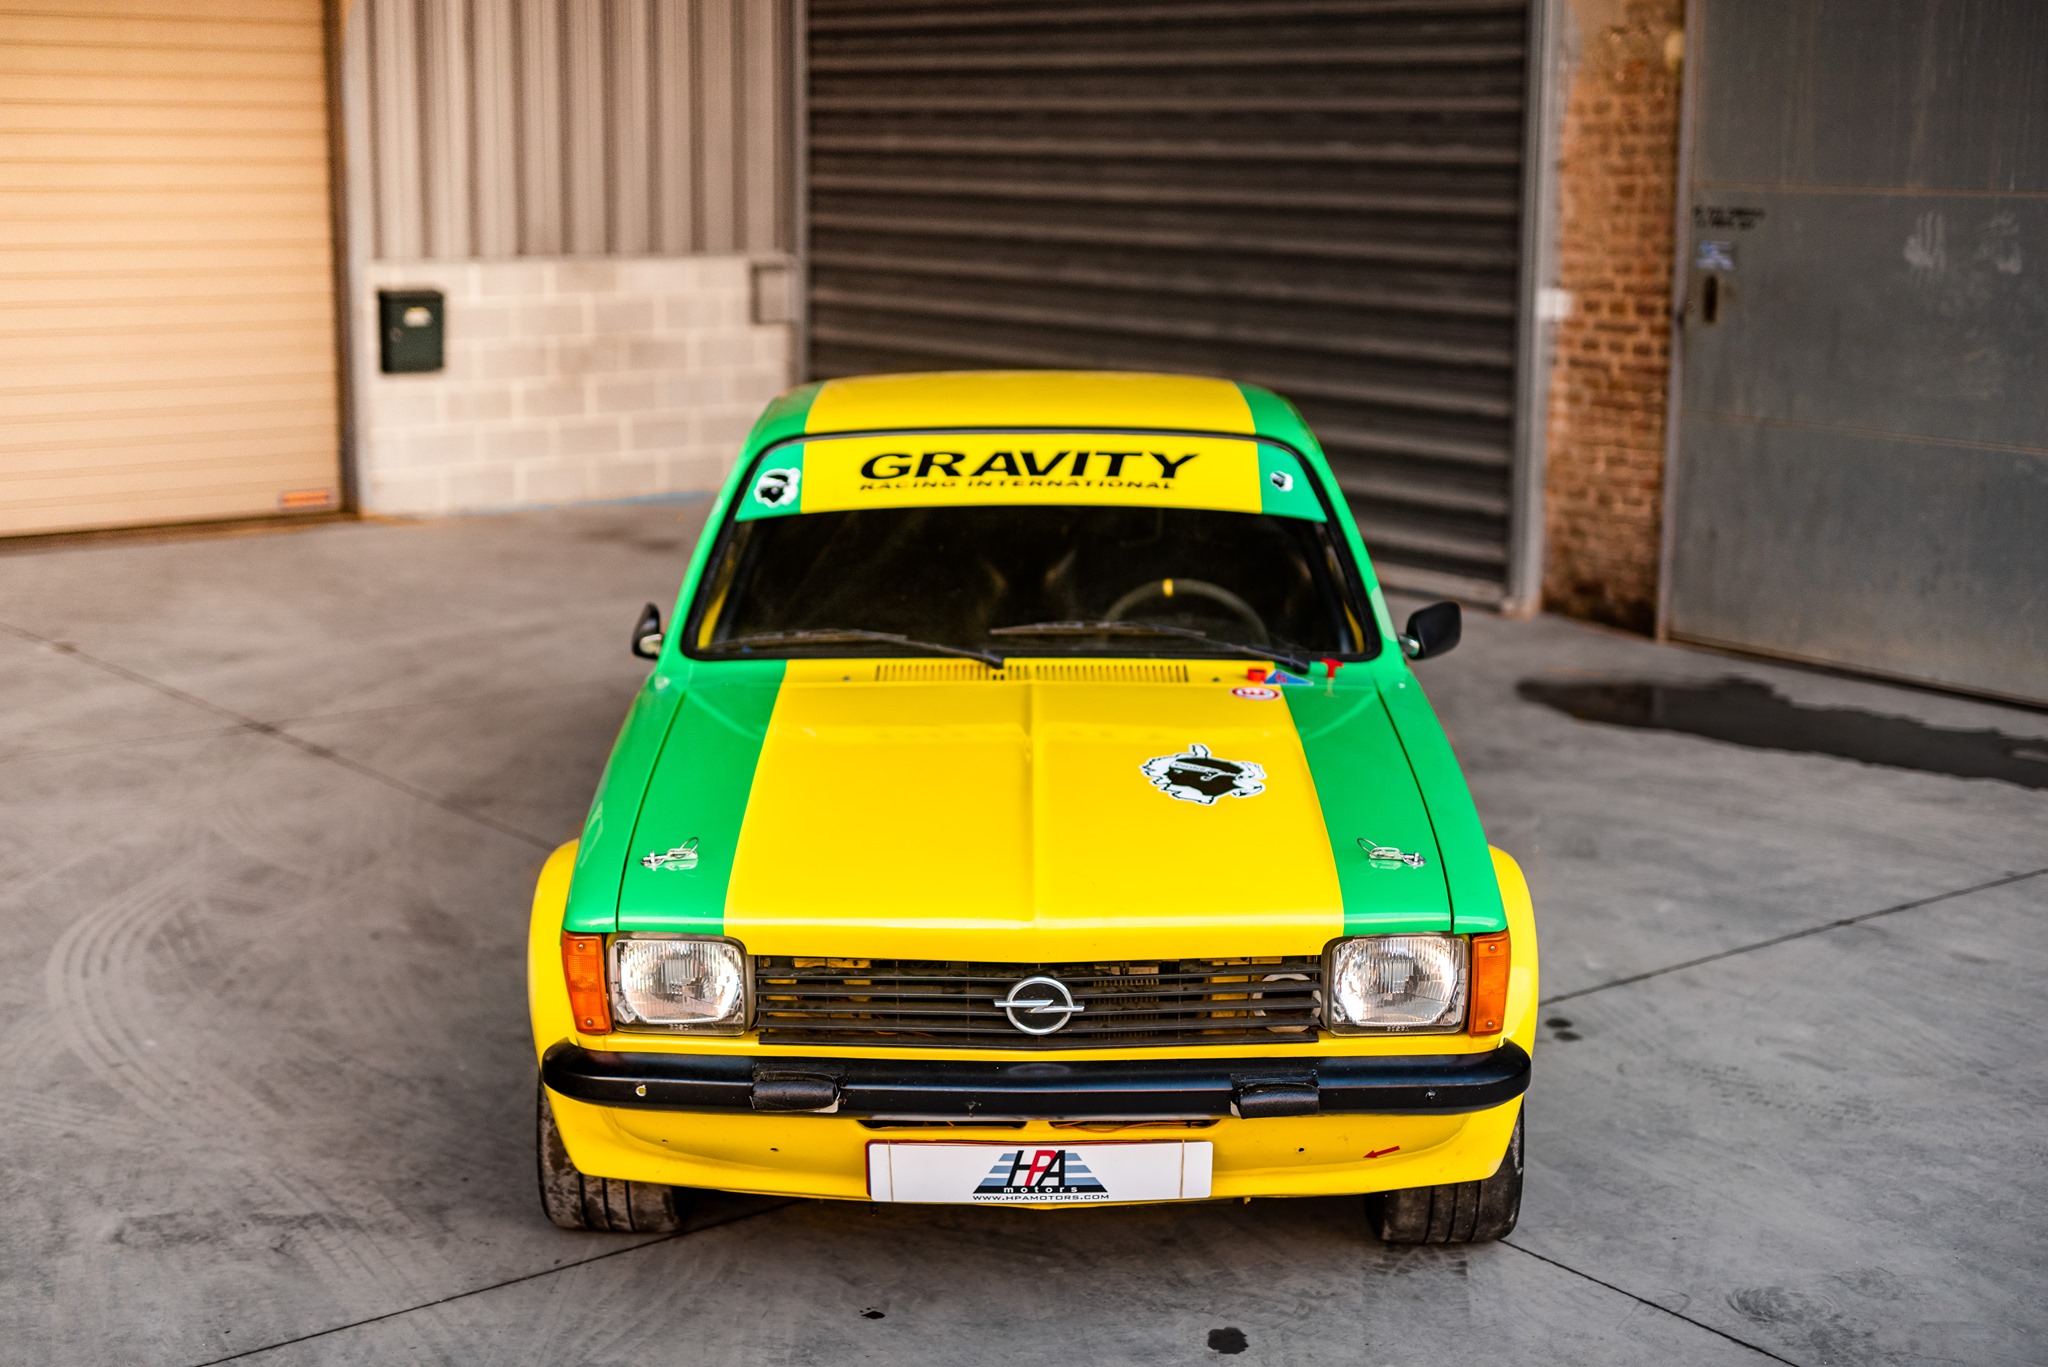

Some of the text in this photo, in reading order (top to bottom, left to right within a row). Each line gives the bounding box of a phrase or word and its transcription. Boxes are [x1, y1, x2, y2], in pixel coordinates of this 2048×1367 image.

[861, 451, 1199, 479] GRAVITY
[860, 480, 1174, 490] RACING INTERNATIONAL
[1006, 1149, 1066, 1187] HPA
